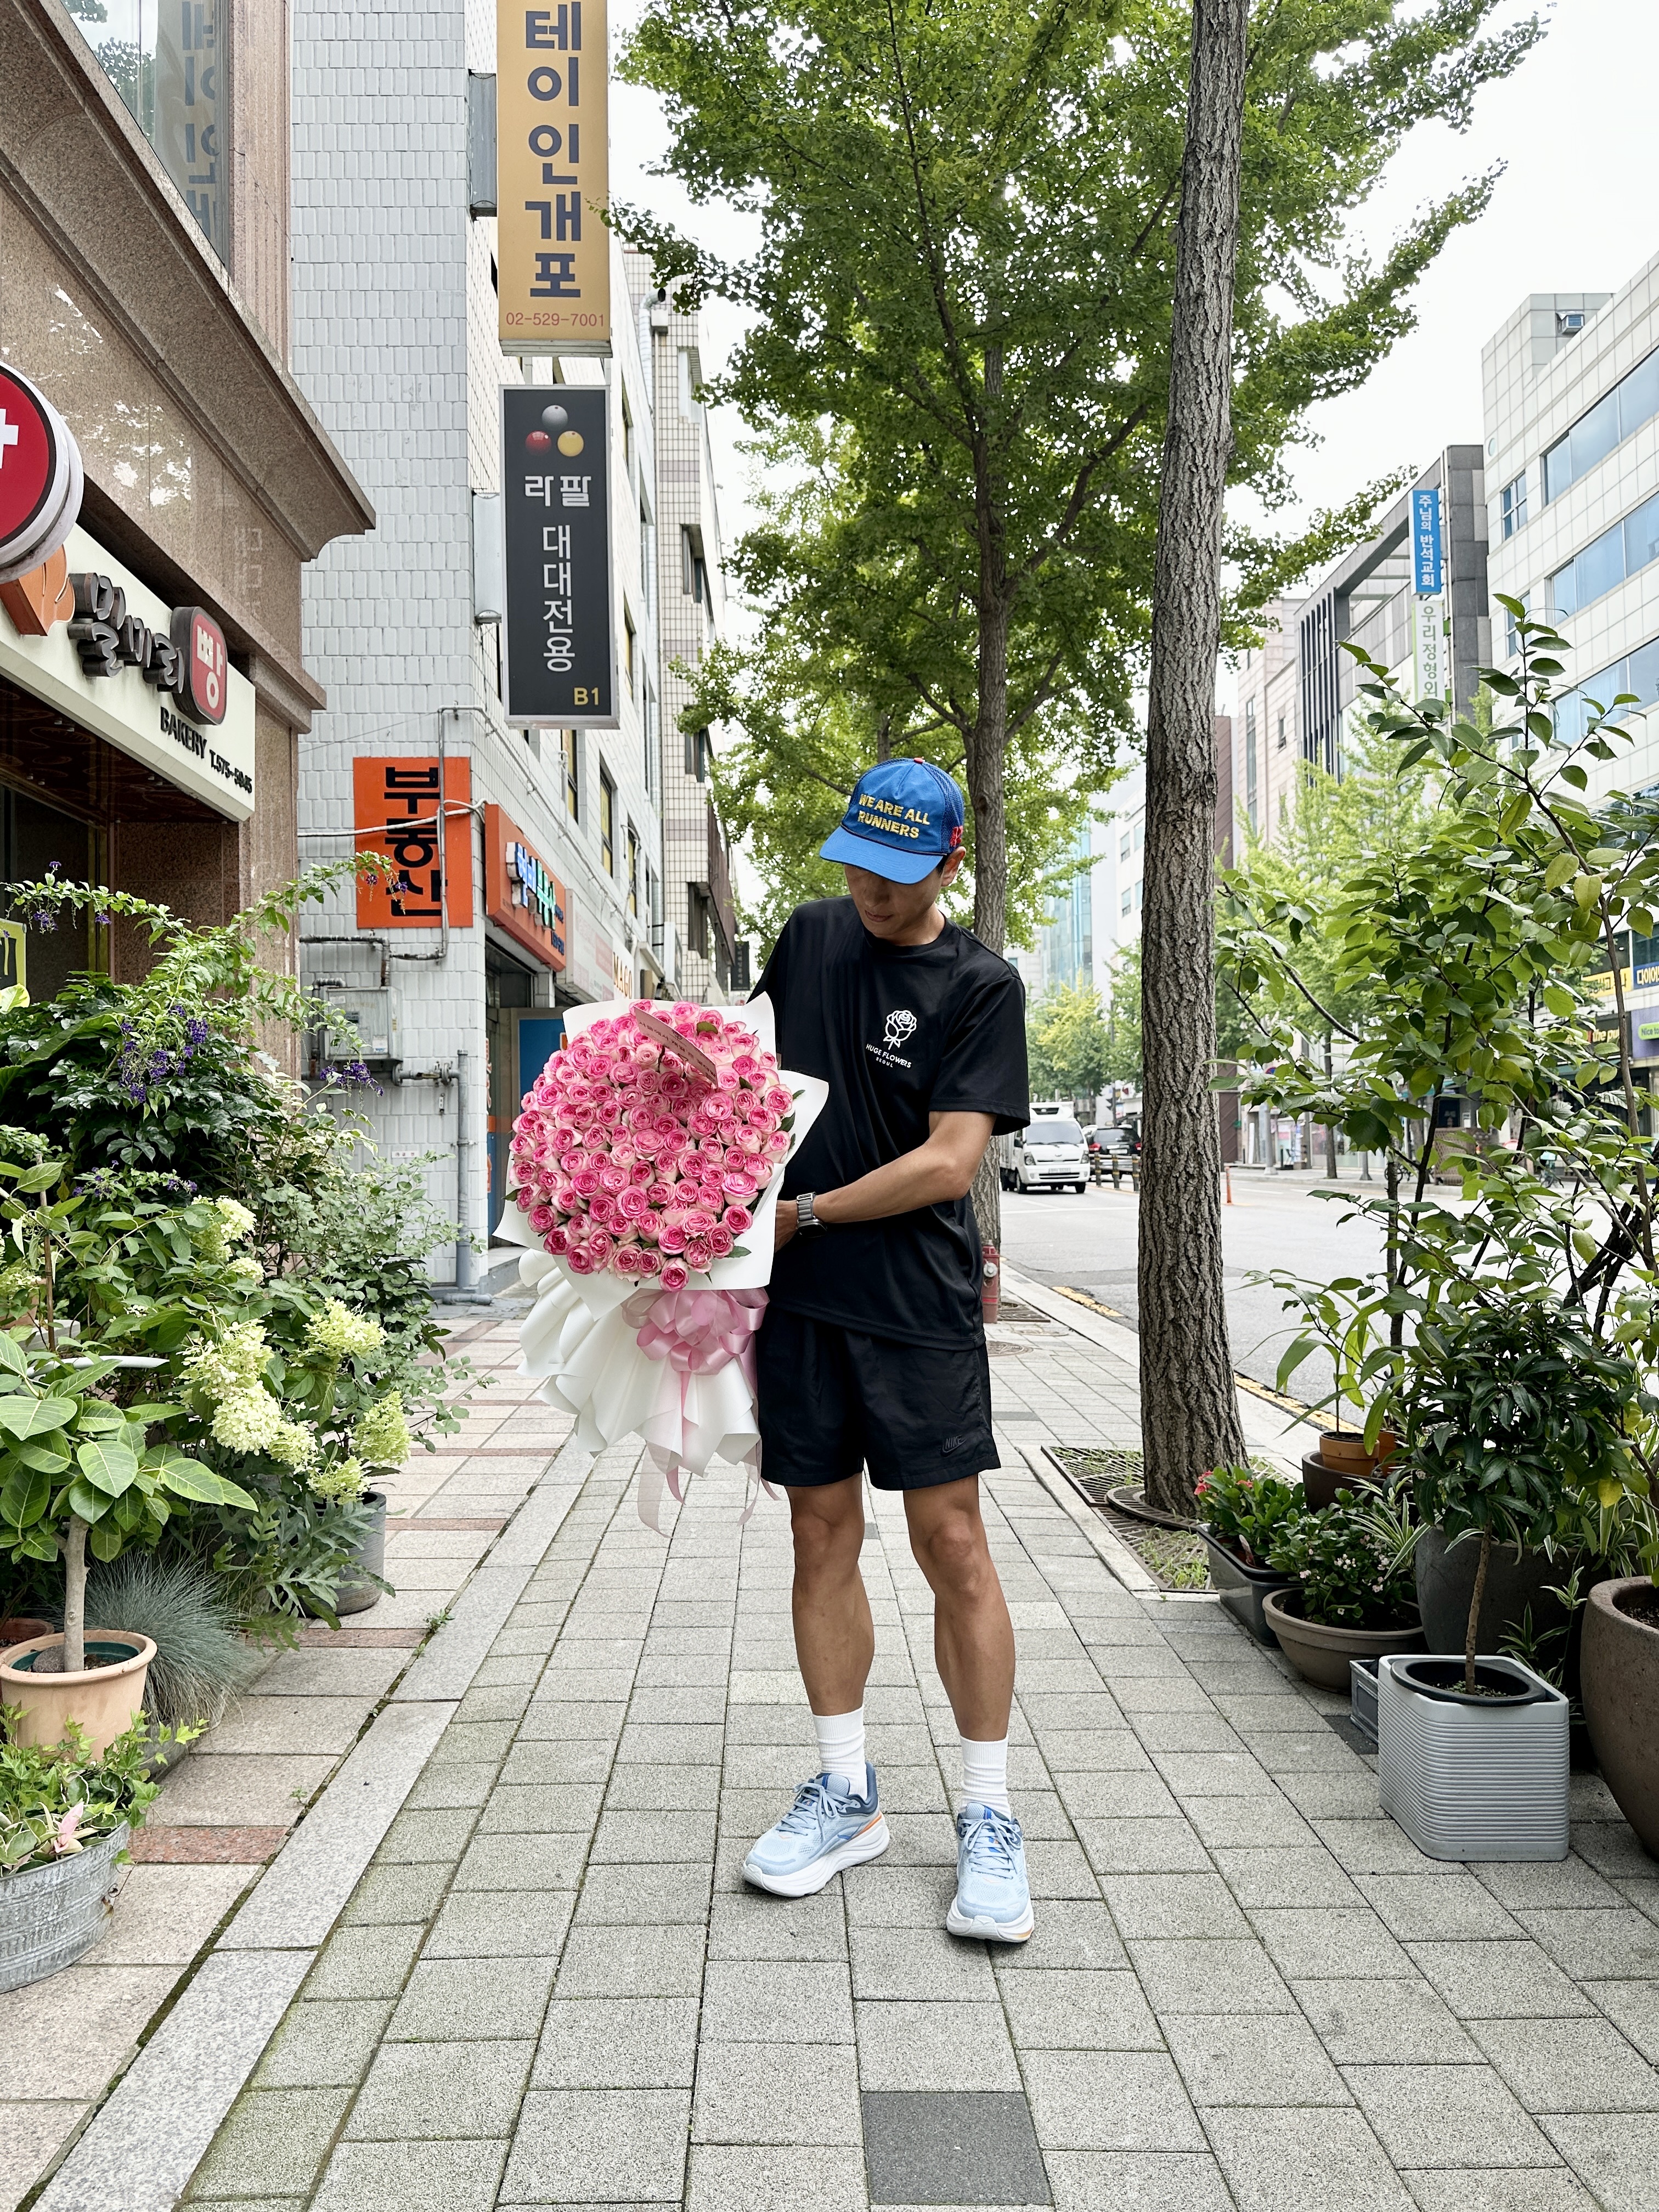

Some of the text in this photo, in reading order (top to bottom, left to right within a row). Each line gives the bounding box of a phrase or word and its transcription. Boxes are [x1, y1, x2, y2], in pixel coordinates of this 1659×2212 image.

[505, 312, 605, 328] 02-529-7001
[524, 475, 592, 507] 라팔
[1418, 495, 1435, 588] 주님의 반석교회
[542, 524, 575, 673] 대대전용
[573, 687, 600, 707] B1
[160, 706, 207, 759] BAKERY
[857, 810, 919, 839] RUNNERS
[859, 794, 930, 825] WE ARE ALL
[383, 766, 448, 917] 부동산
[613, 951, 633, 999] MAGO
[865, 1043, 912, 1068] HUGE FLOWERS
[876, 1057, 893, 1068] SEOUL
[946, 1436, 962, 1448] NIKE
